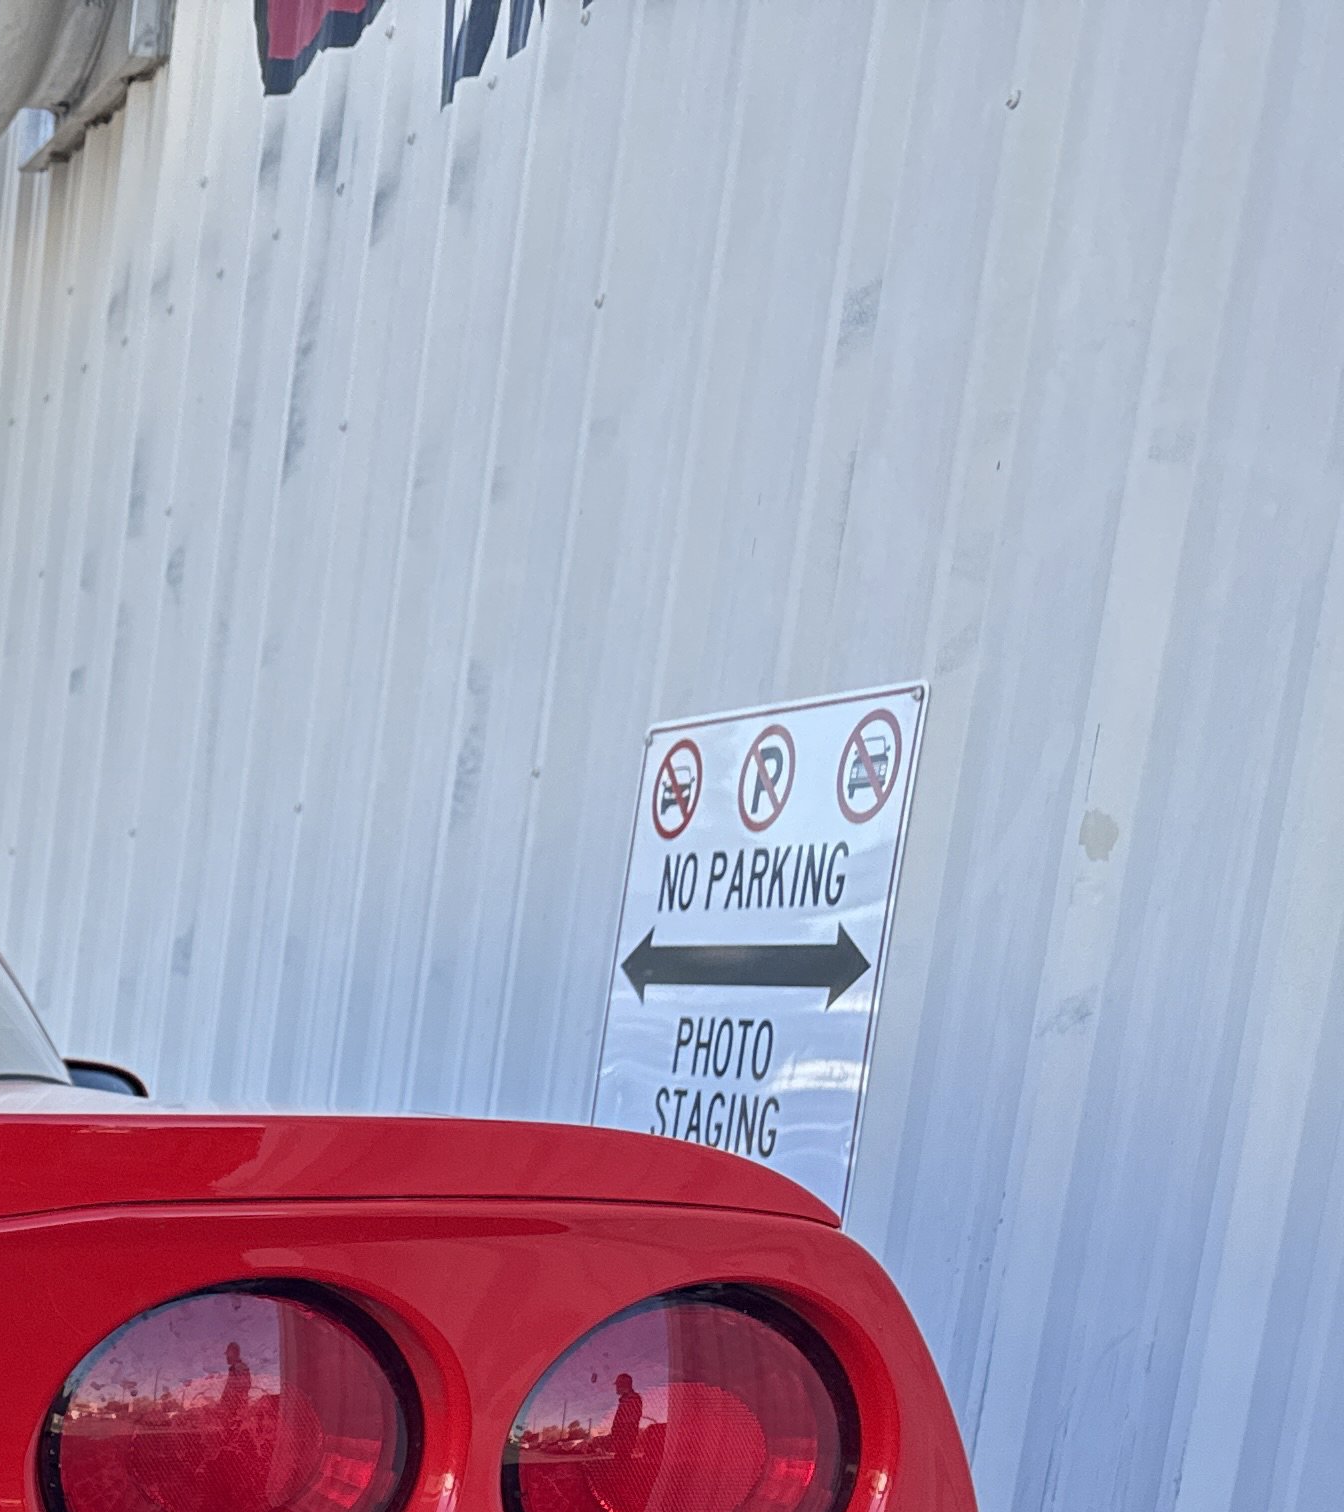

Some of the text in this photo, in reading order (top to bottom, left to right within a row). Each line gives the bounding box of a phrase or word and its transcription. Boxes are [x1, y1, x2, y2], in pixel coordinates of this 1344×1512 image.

[658, 841, 849, 912] NO PARKING
[672, 1016, 773, 1080] PHOTO
[651, 1086, 780, 1158] STAGING
